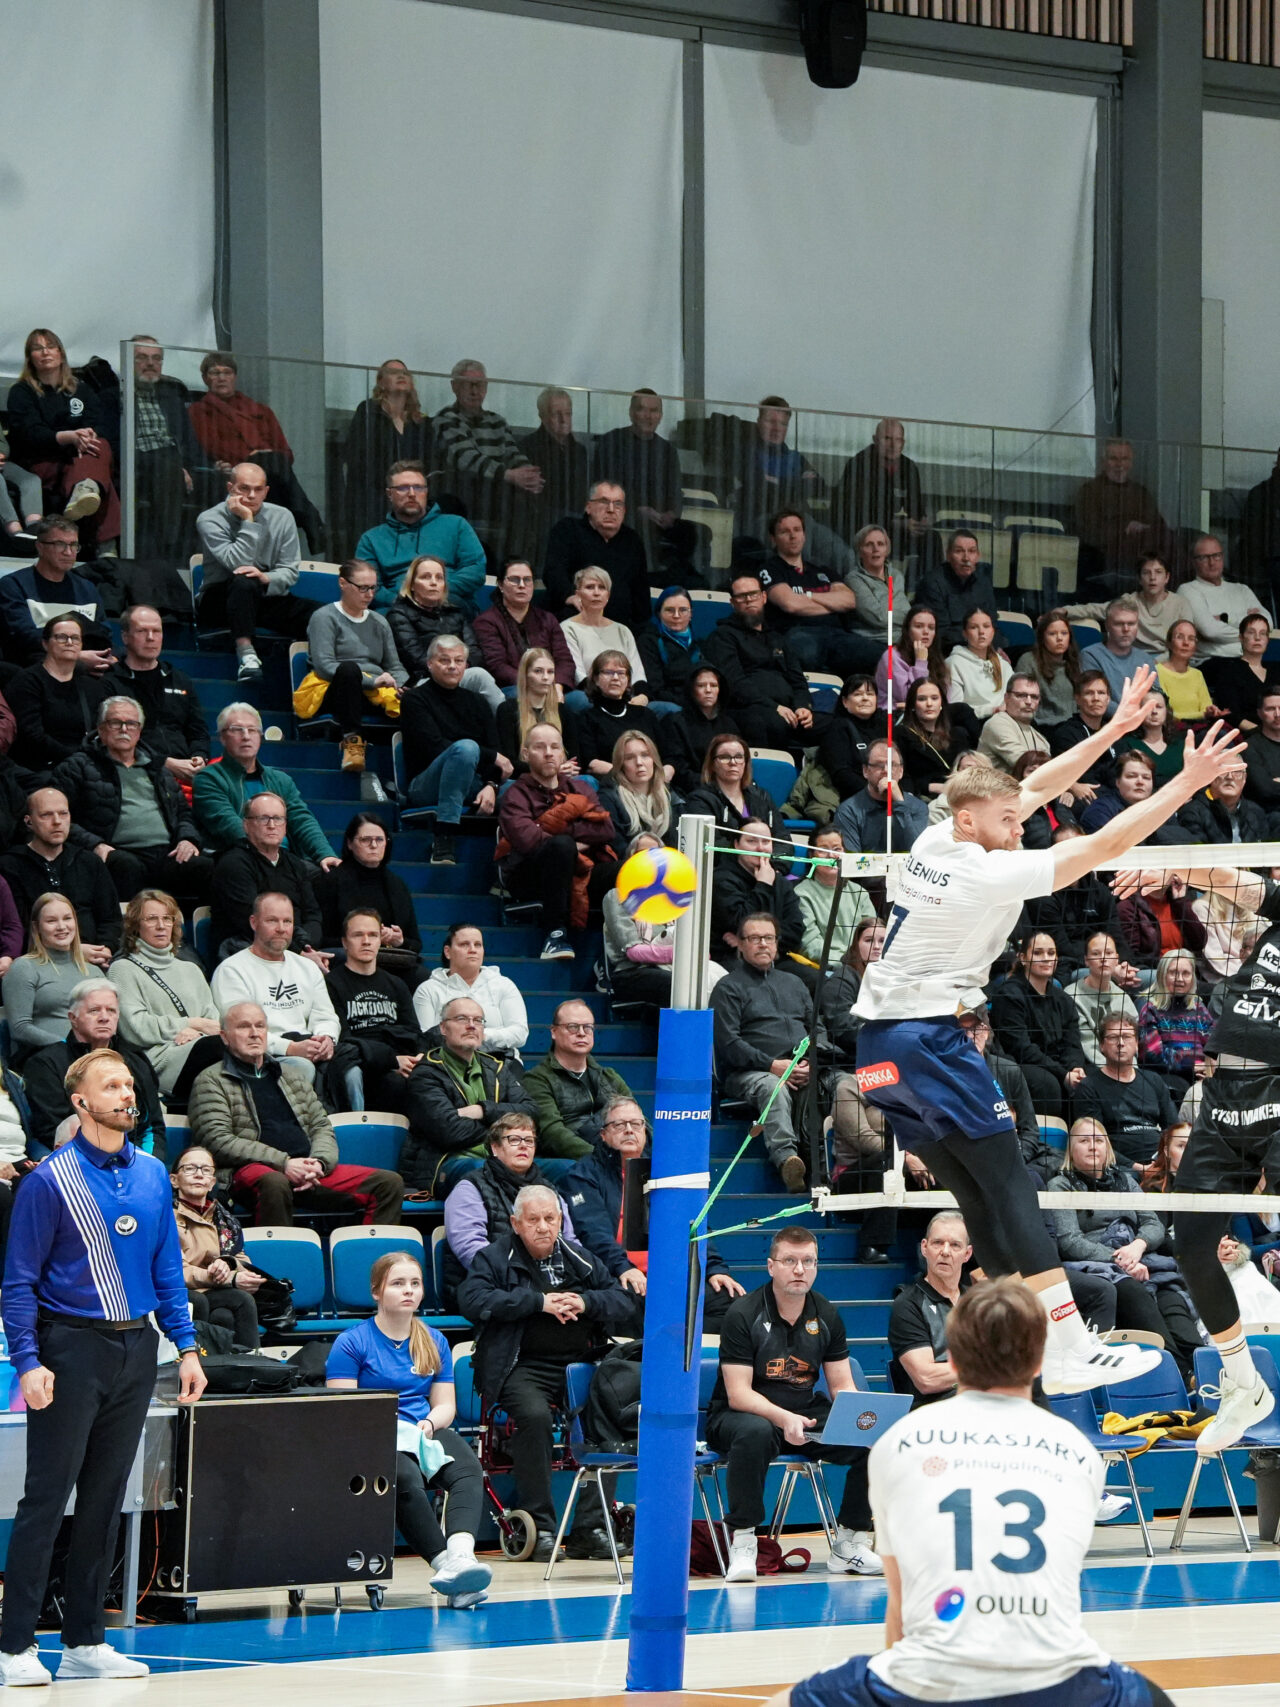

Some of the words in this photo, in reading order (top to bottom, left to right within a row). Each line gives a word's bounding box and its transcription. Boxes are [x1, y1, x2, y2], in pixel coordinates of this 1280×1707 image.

[882, 904, 910, 959] 7
[938, 1488, 1047, 1575] 13
[975, 1594, 1048, 1617] OULU
